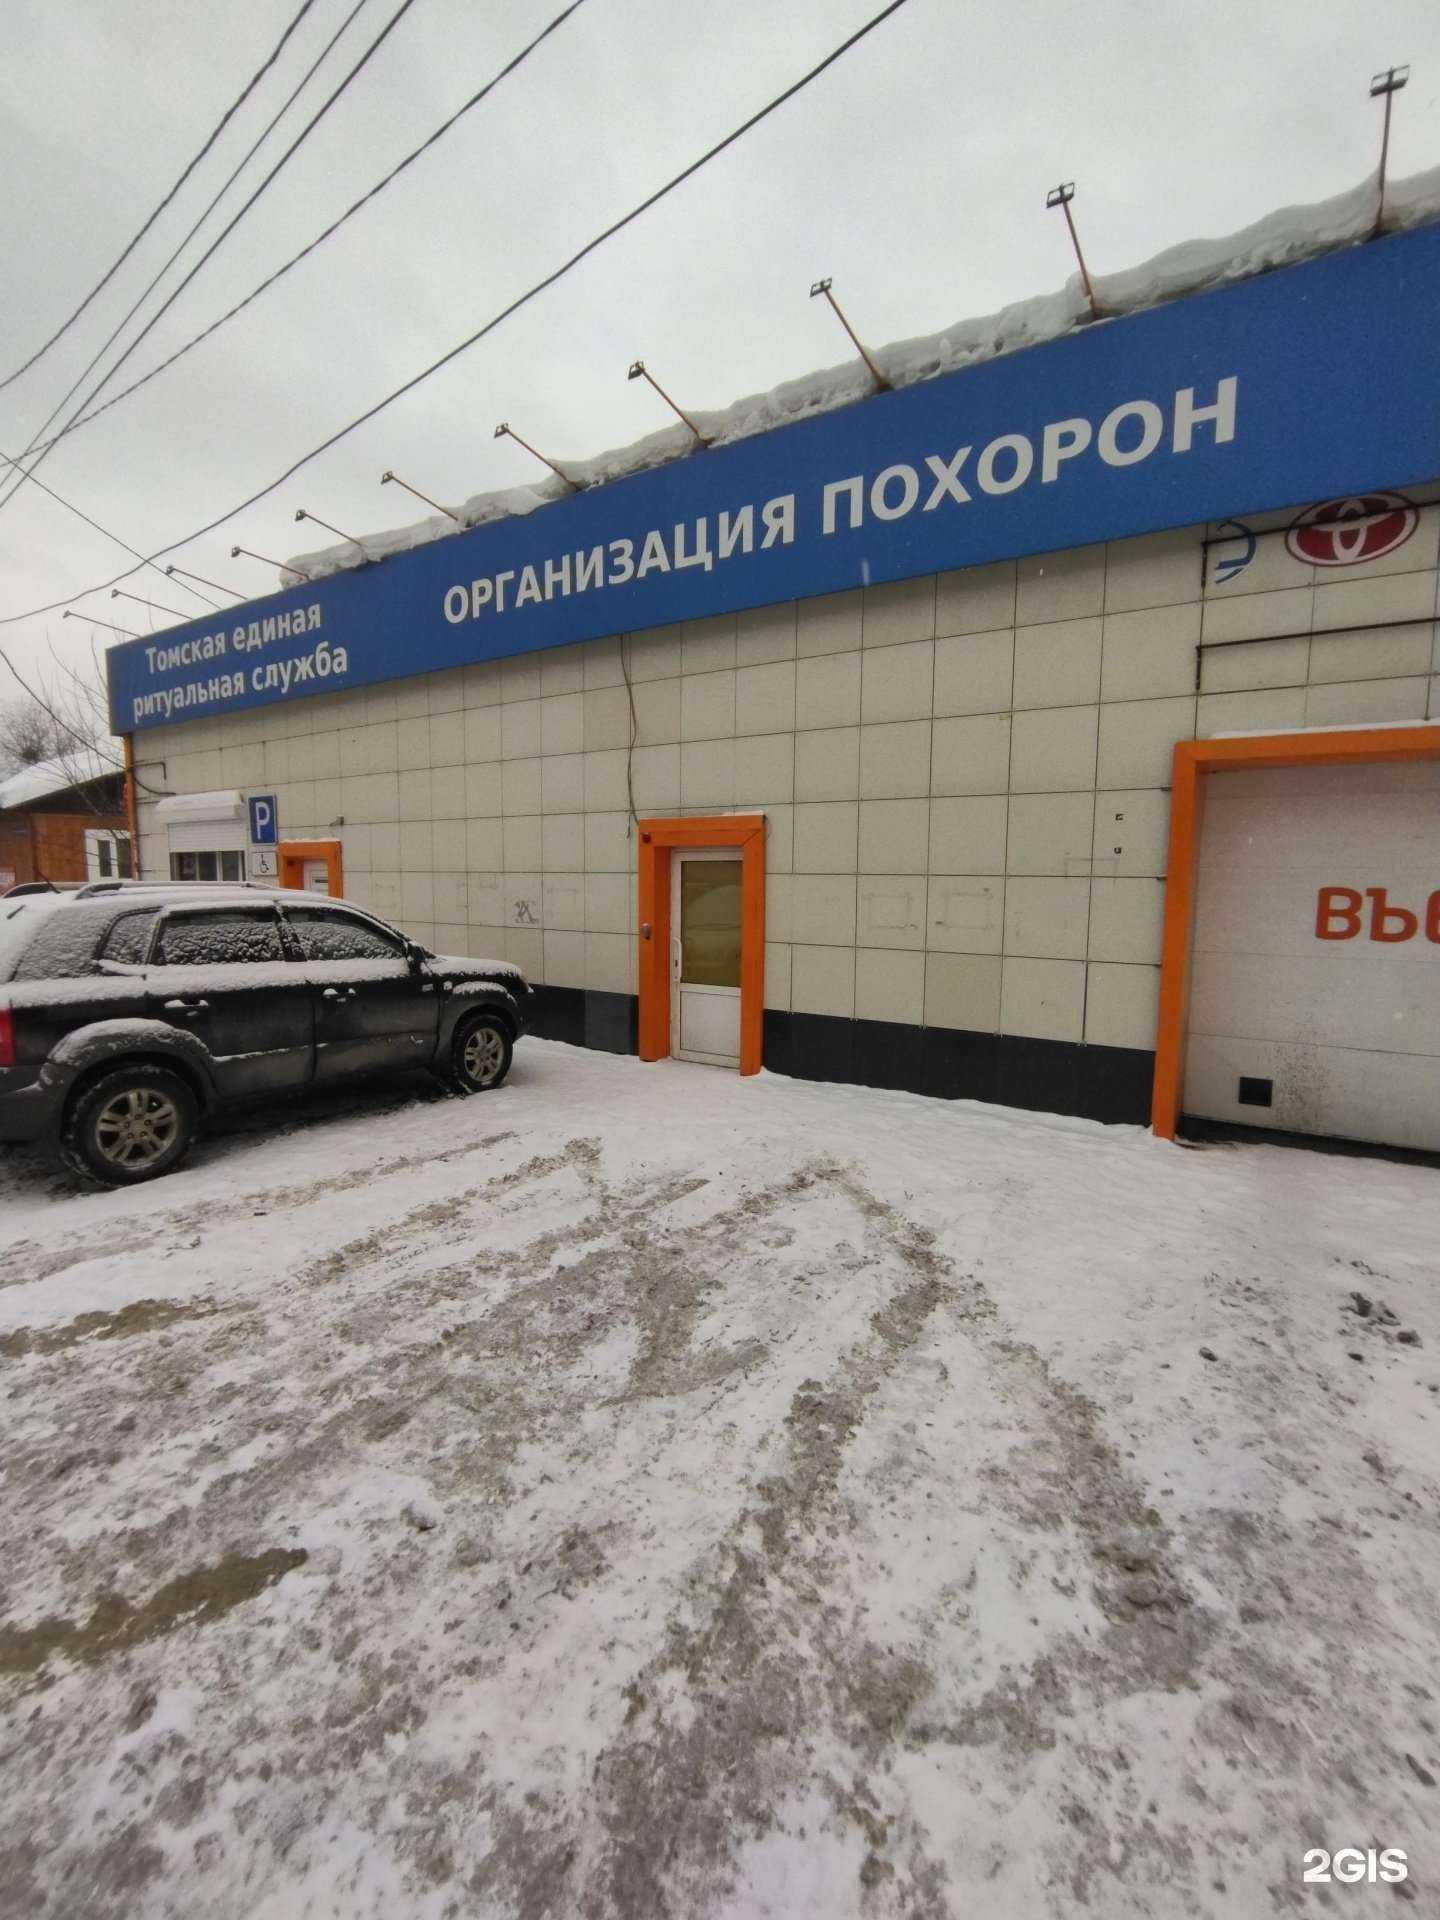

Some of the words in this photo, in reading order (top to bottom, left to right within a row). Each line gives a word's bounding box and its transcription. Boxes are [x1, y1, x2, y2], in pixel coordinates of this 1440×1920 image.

[443, 493, 796, 625] ОРГАНИЗАЦИЯ
[822, 375, 1239, 536] ПОХОРОН
[144, 630, 226, 675] Томская
[232, 603, 322, 652] единая
[132, 671, 245, 724] ритуальная
[251, 640, 348, 695] служба
